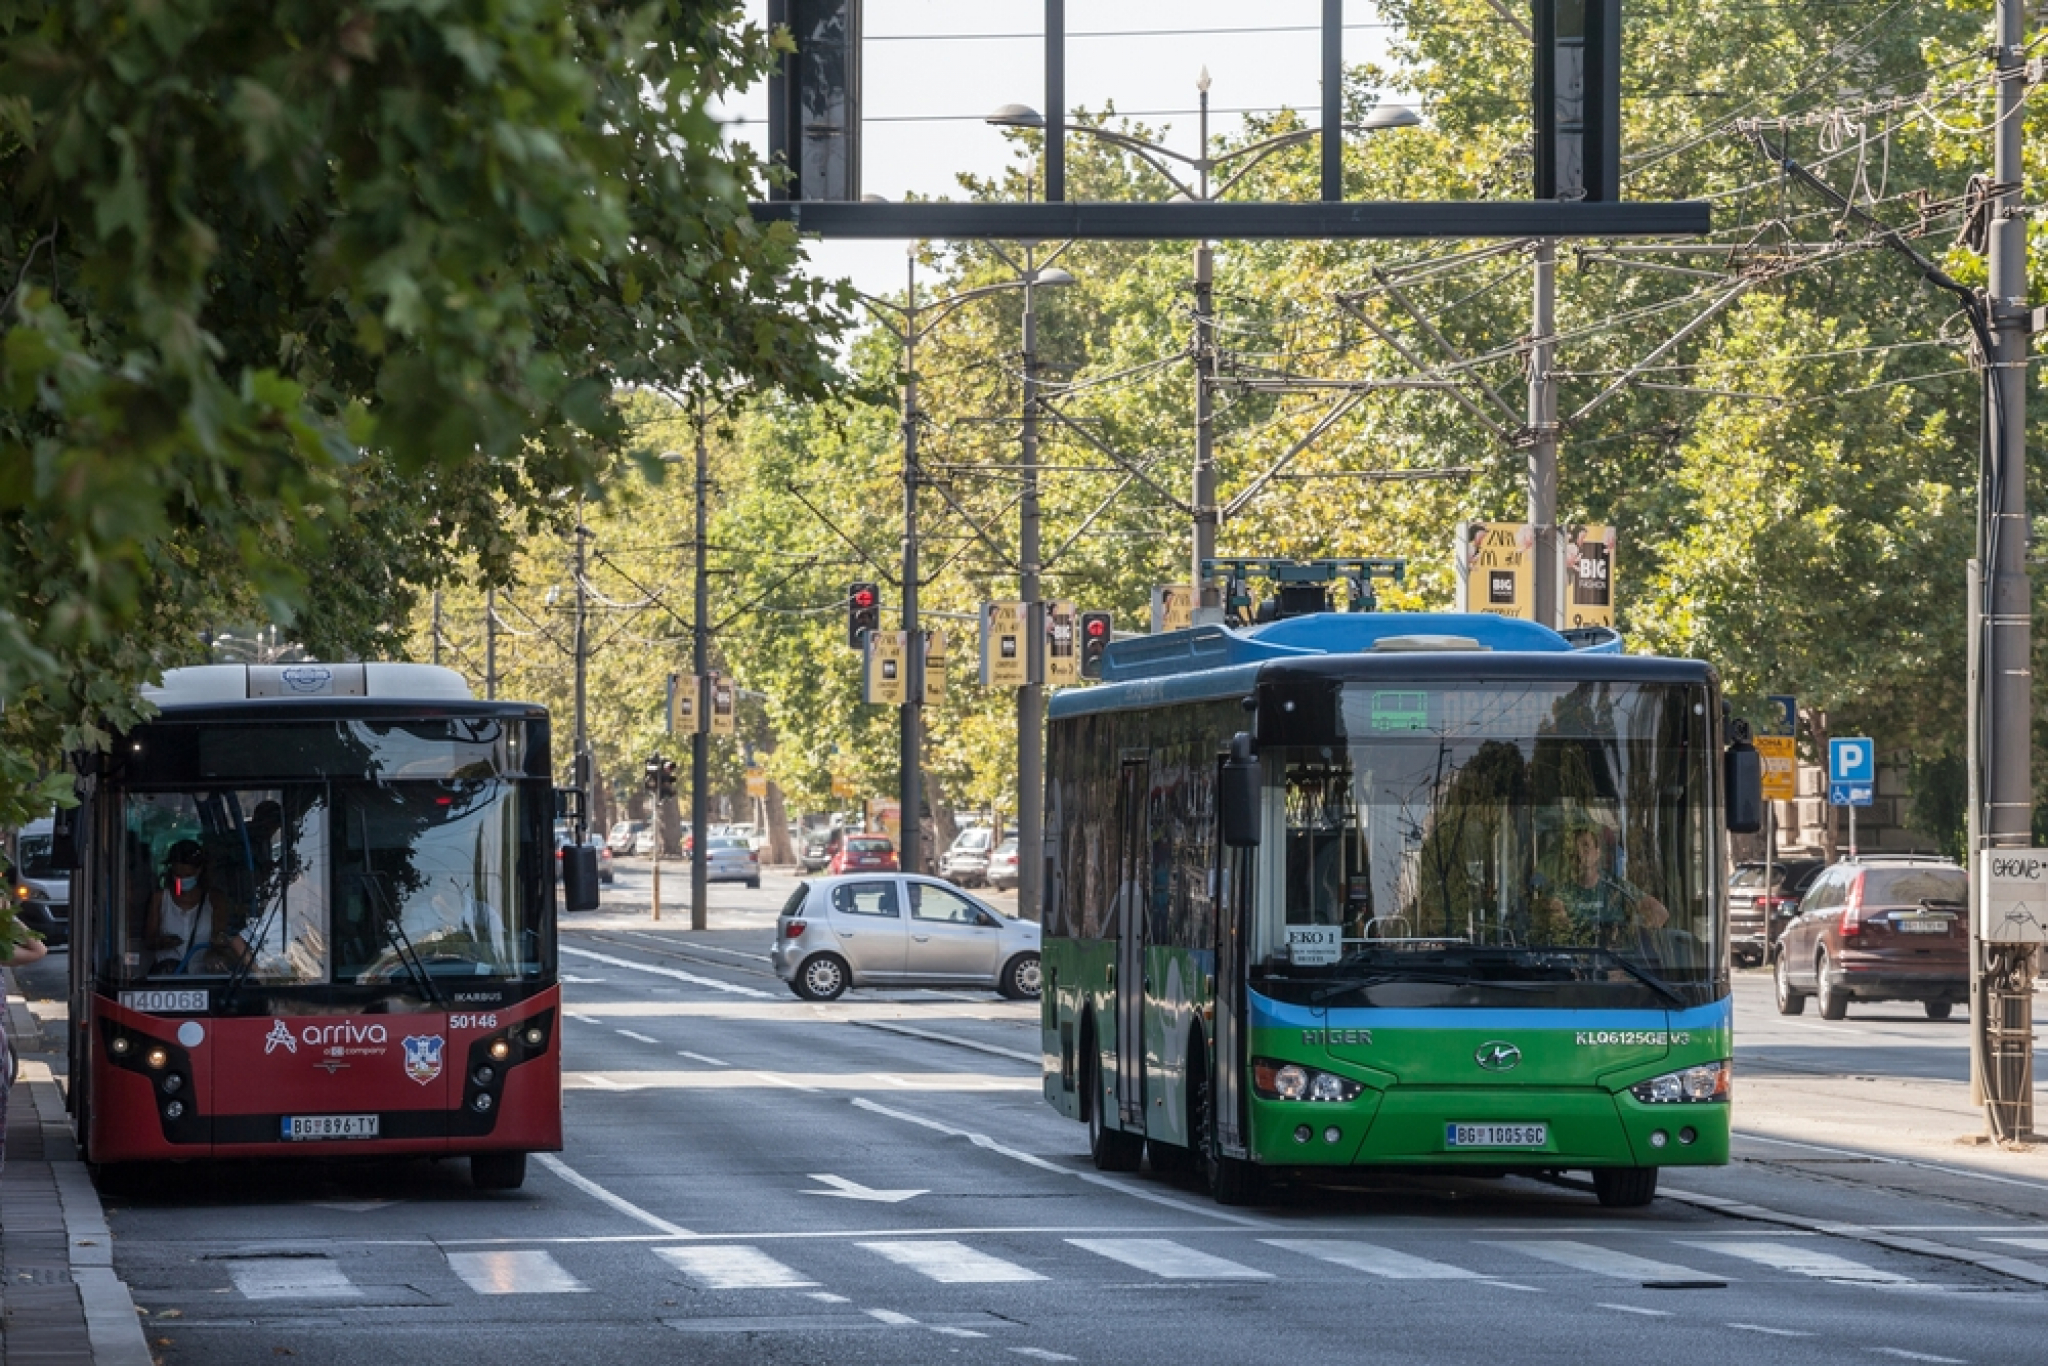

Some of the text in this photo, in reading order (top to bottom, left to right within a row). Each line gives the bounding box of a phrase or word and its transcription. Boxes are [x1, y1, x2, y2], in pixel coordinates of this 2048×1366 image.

[1580, 559, 1606, 579] BIG
[1839, 745, 1863, 776] P
[450, 1014, 498, 1029] 50146
[302, 1019, 388, 1045] arriva
[1302, 1029, 1372, 1045] HIGER
[1457, 1127, 1476, 1144] BG
